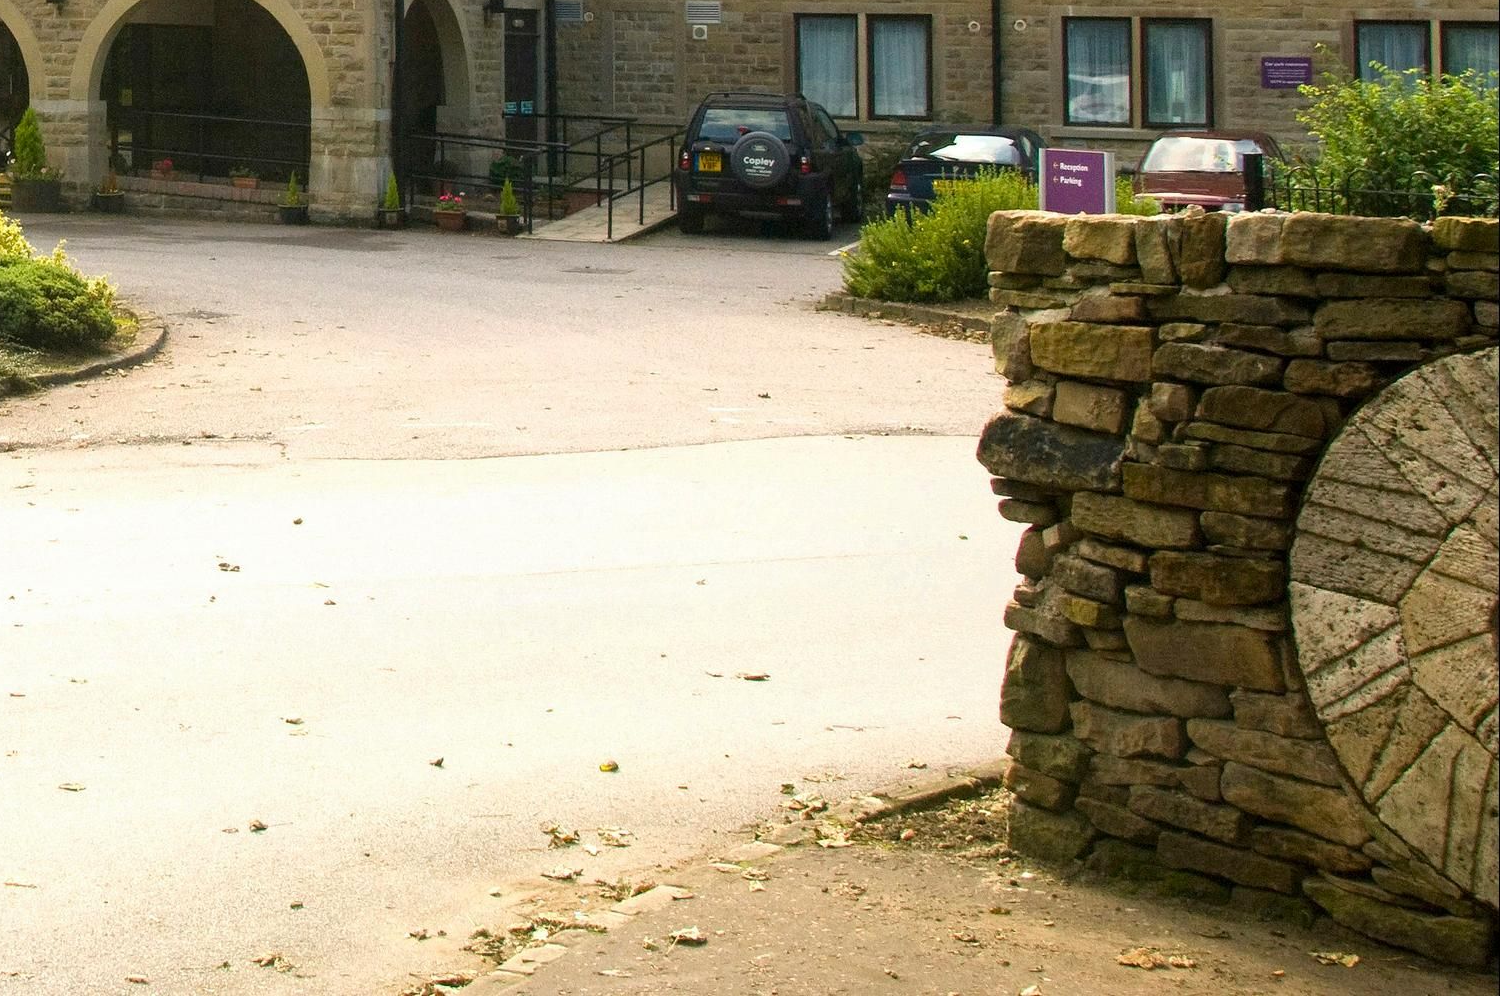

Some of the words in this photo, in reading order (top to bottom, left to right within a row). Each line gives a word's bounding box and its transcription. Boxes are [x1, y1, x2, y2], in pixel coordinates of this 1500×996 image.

[743, 156, 775, 167] Copley
[1060, 162, 1089, 172] Reception
[1060, 176, 1082, 187] Parking
